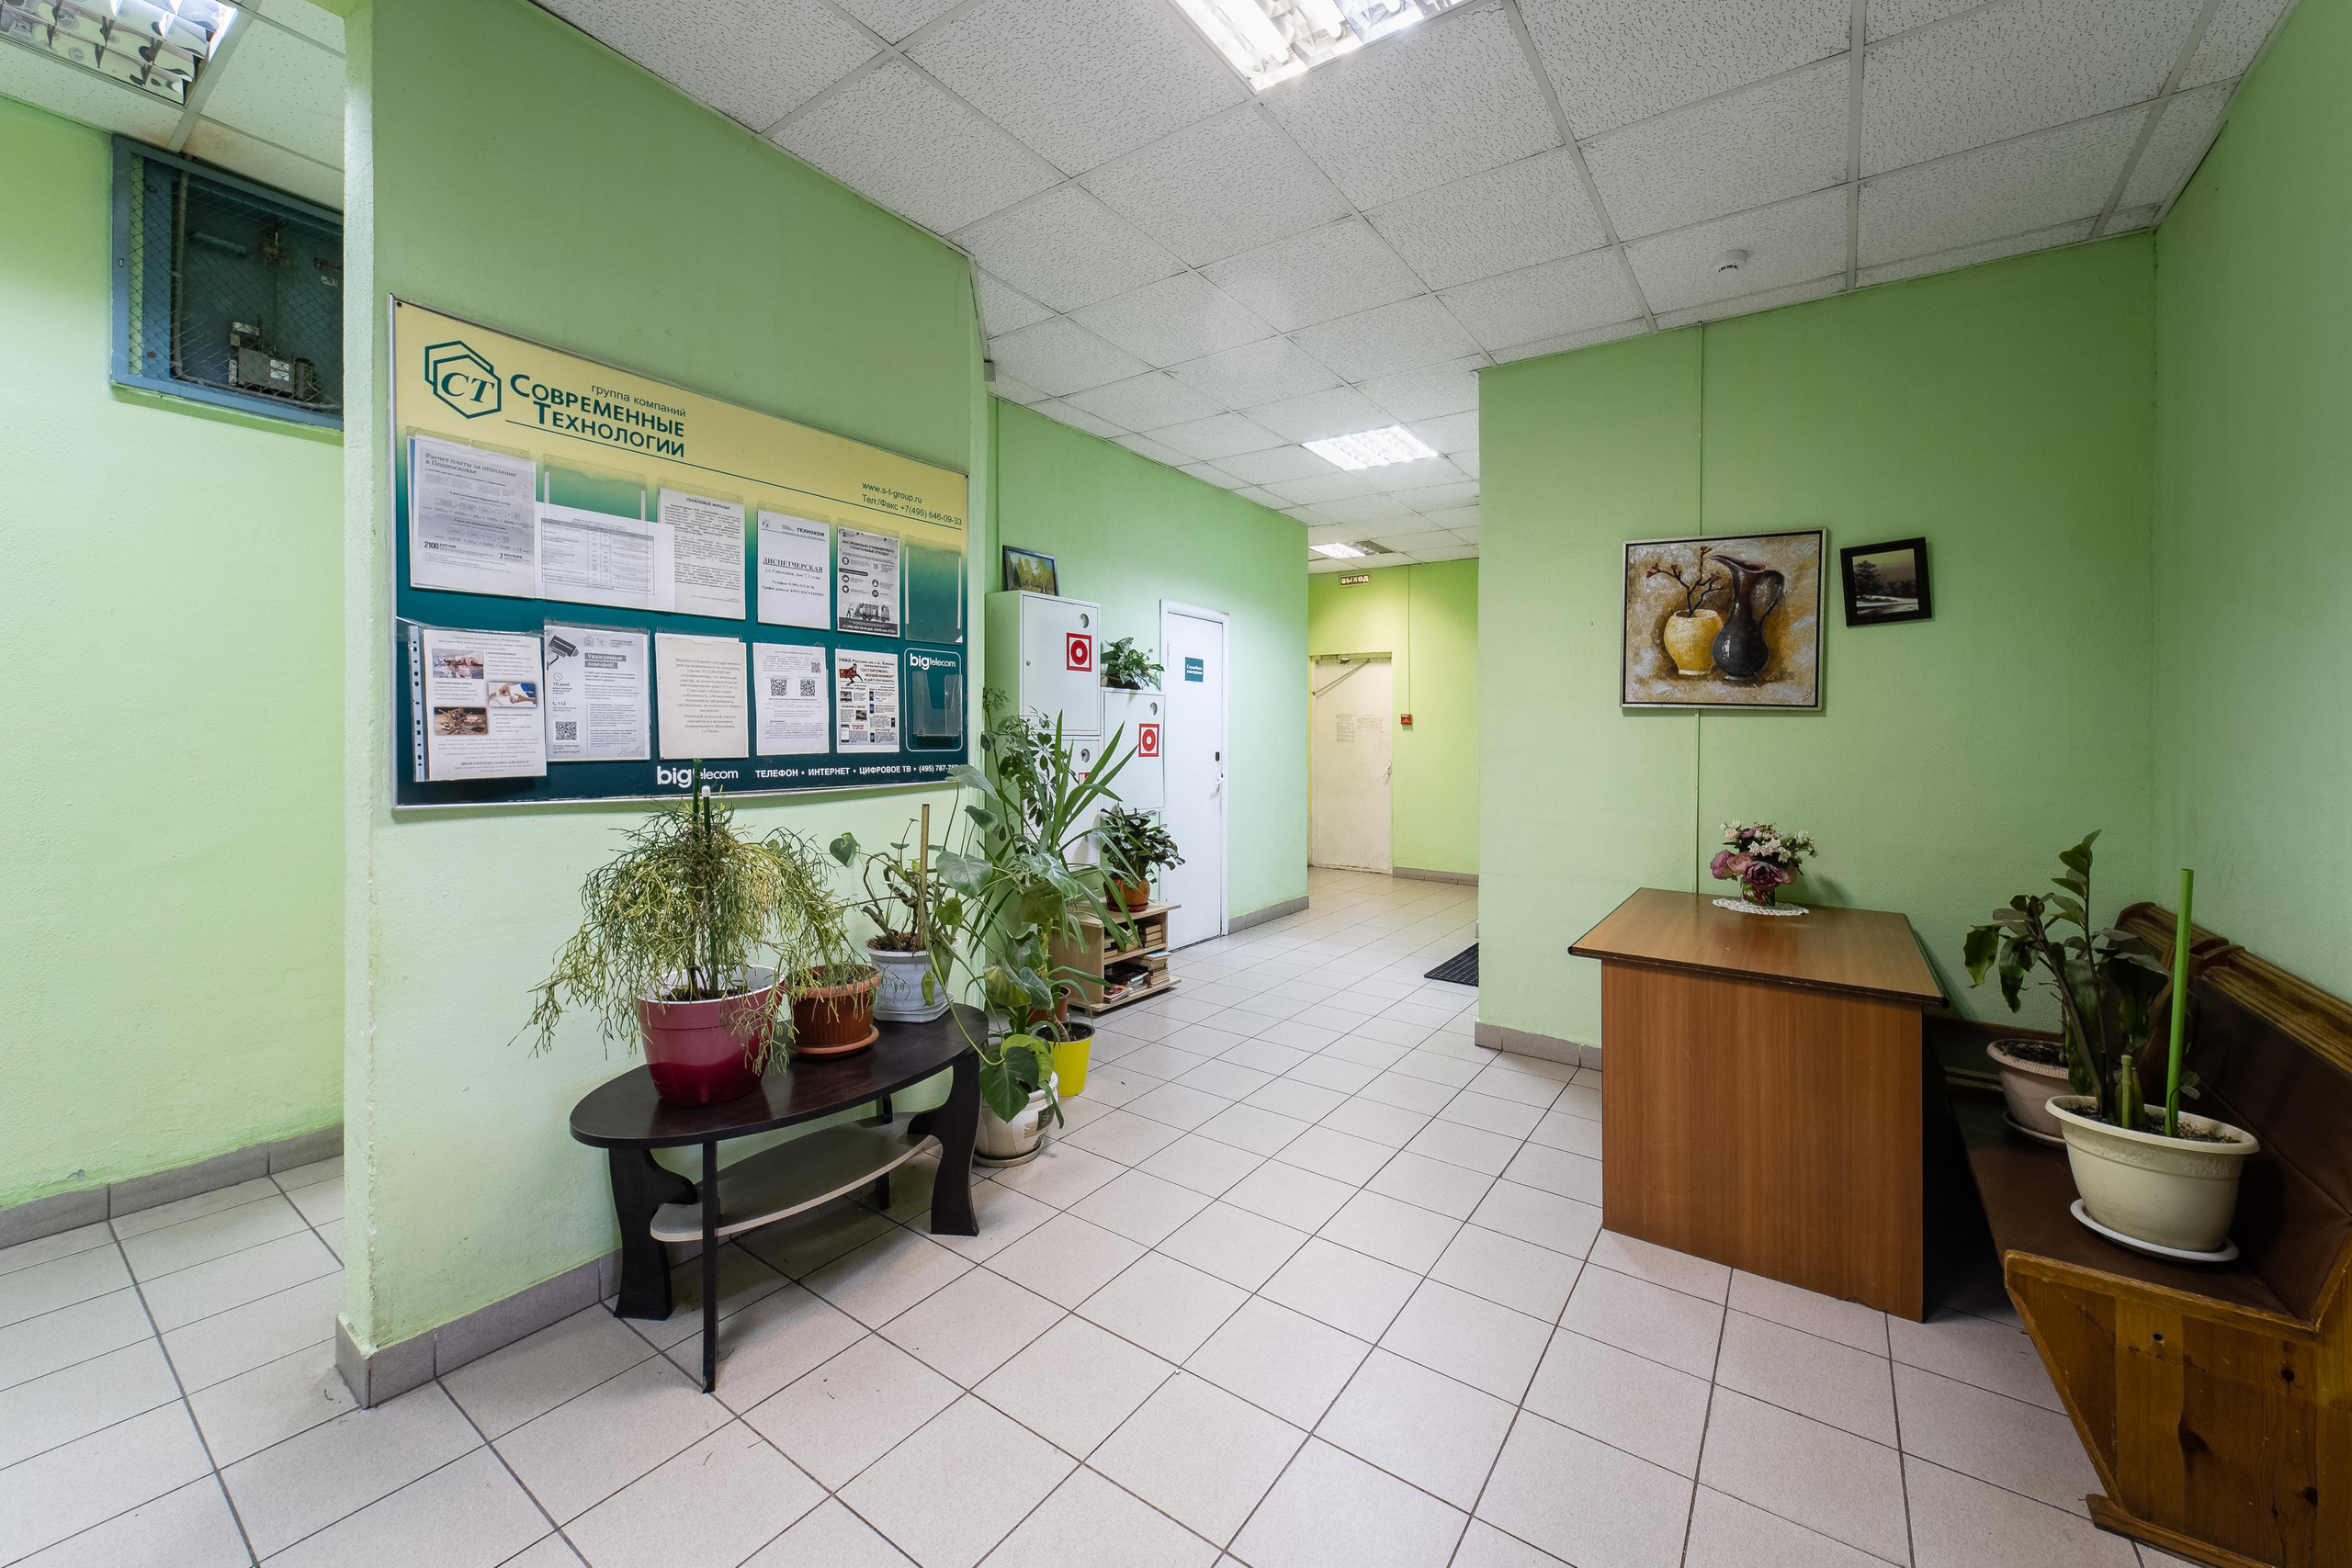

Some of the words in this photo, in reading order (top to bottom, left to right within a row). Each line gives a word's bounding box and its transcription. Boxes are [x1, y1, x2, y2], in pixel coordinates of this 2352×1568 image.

[441, 372, 495, 403] СТ
[591, 385, 631, 403] группа
[634, 396, 686, 418] компаний
[425, 452, 449, 463] Расчет
[450, 458, 472, 468] платы
[481, 466, 517, 477] отопление
[431, 459, 478, 475] Подмосковье
[862, 482, 922, 503] www.s-t-group.ru
[862, 493, 899, 511] Тел./Факс
[900, 504, 927, 519] +7(495)
[928, 511, 962, 525] 646-09-33
[796, 527, 825, 537] ТЕХНОКОМ
[424, 540, 439, 550] 2100
[762, 557, 823, 573] ДИСПЕТЧЕРСКАЯ
[1341, 575, 1369, 584] ВЫХОД
[588, 653, 624, 661] Уважаемые
[910, 652, 956, 671] bigtelecom
[754, 768, 798, 779] ТЕЛЕФОН
[808, 766, 851, 777] ИНТЕРНЕТ
[859, 765, 901, 775] ЦИФРОВОЕ
[902, 764, 911, 773] ТВ
[919, 764, 934, 773] (495)
